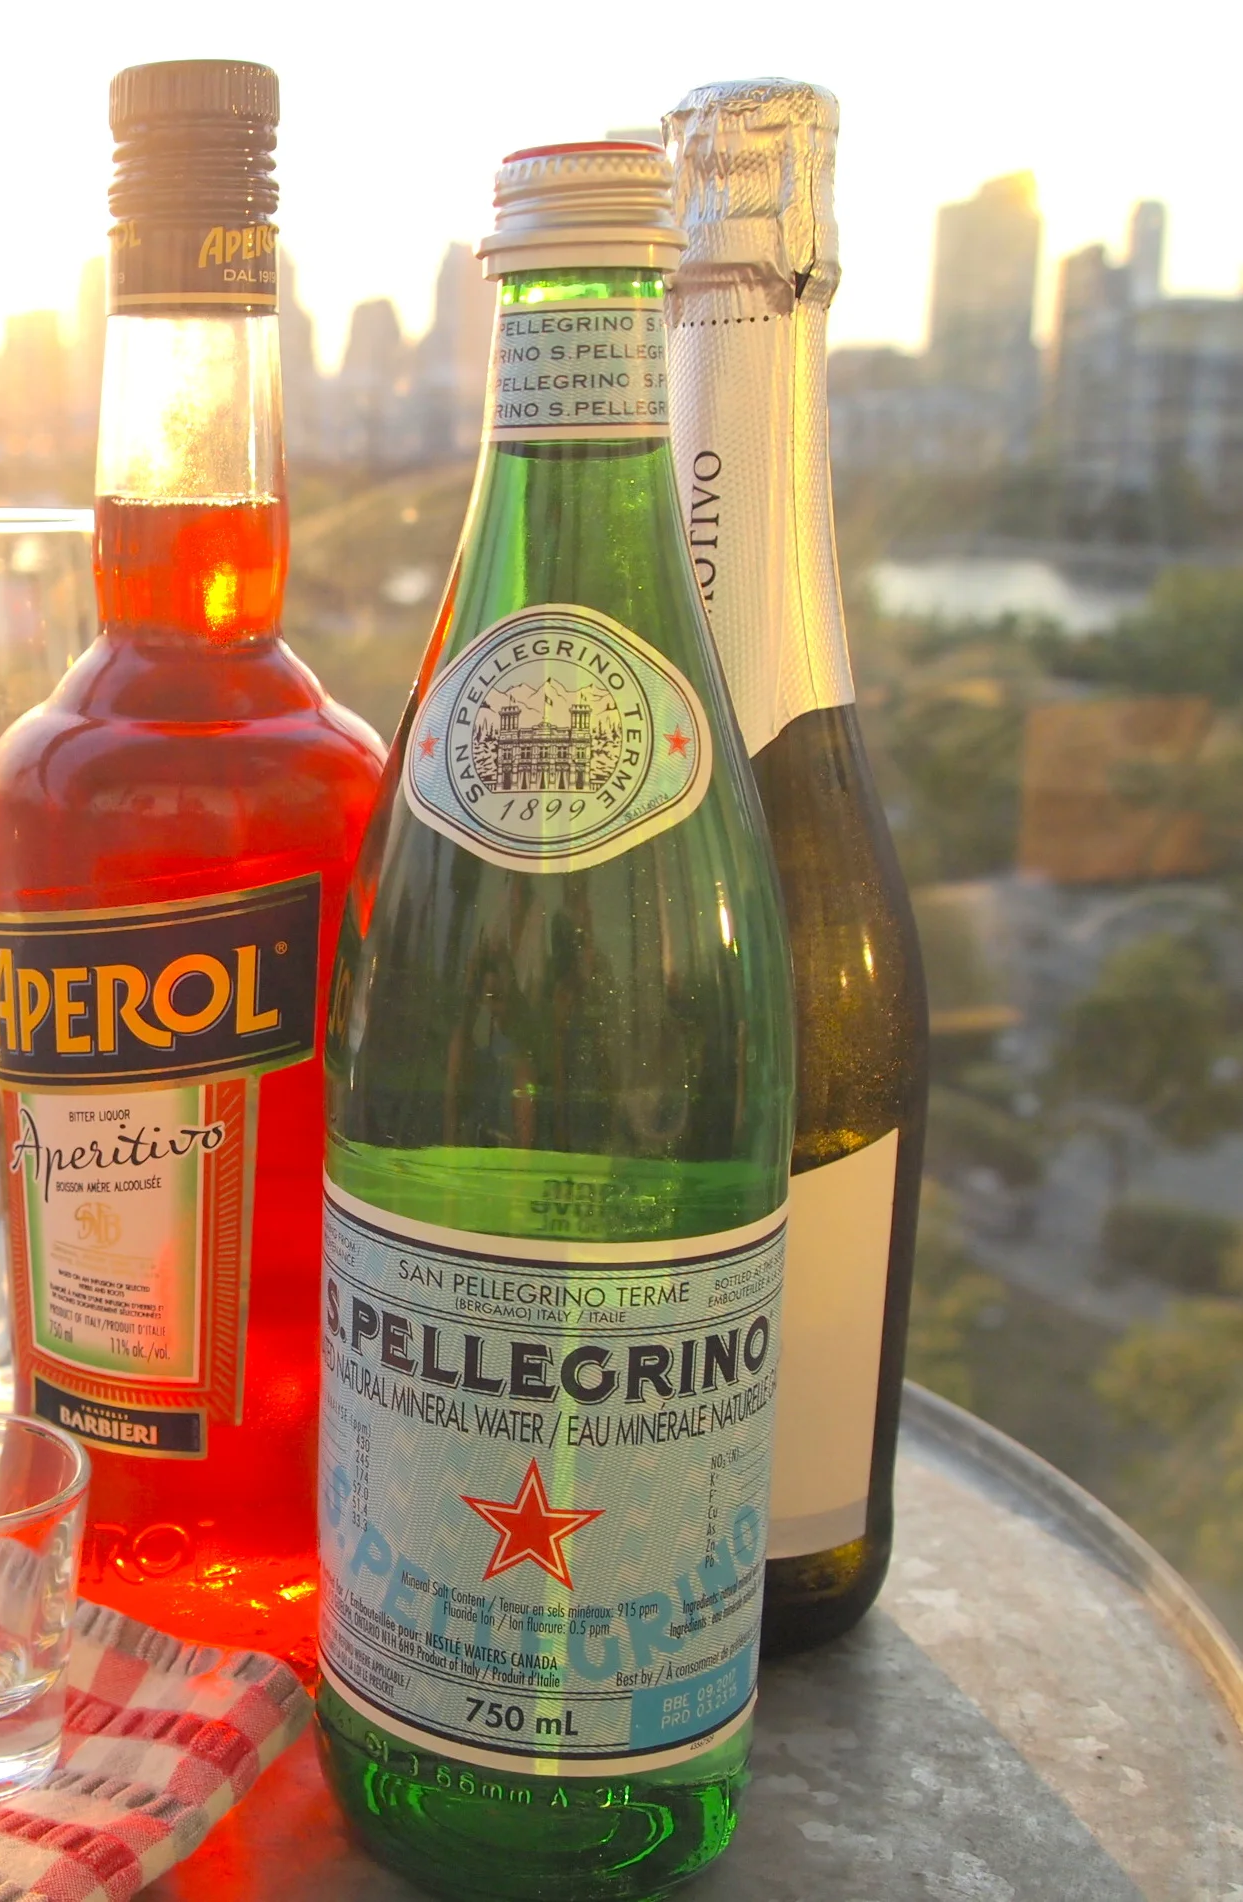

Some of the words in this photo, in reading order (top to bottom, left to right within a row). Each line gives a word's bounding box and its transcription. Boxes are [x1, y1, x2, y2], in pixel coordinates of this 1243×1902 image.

[224, 269, 256, 281] DAL
[690, 450, 722, 613] OTIVO
[456, 639, 626, 726] PELLEGRINO
[455, 744, 485, 804] SAN
[596, 702, 644, 810] TERME
[499, 798, 586, 822] 1899
[68, 1110, 95, 1123] BITTER
[99, 1109, 131, 1121] LIQUOR
[12, 1107, 225, 1203] Aperitivo
[55, 1181, 84, 1192] BOISSON
[87, 1178, 111, 1192] AMÈRE
[114, 1174, 162, 1191] ALCOOLISÉE
[398, 1258, 444, 1289] SAN
[453, 1272, 606, 1309] PELLEGRINO
[616, 1282, 690, 1307] TERME
[714, 1270, 752, 1290] BOTTLED
[455, 1296, 532, 1322] (BERGAMO)
[537, 1308, 572, 1323] ITALY
[589, 1311, 626, 1323] ITALIE
[49, 1319, 63, 1339] 750
[111, 1337, 130, 1357] 11%
[327, 1278, 770, 1407] S.PELLEGRINO
[336, 1351, 388, 1408] NATURAL
[391, 1383, 469, 1433] MINERAL
[475, 1404, 544, 1444] WATER
[567, 1415, 611, 1447] EAU
[616, 1403, 707, 1446] MINÉRALE
[710, 1375, 769, 1433] NATURELLE
[59, 1404, 159, 1446] BARBIERI
[707, 1506, 719, 1520] Cu
[707, 1523, 716, 1536] As
[704, 1552, 715, 1569] Pb
[706, 1538, 716, 1553] Zn
[401, 1570, 431, 1594] Mineral
[432, 1582, 450, 1599] Salt
[451, 1587, 486, 1609] Content
[499, 1597, 530, 1616] Teneur
[532, 1604, 545, 1617] en
[547, 1602, 566, 1618] sels
[567, 1602, 615, 1620] minéraux:
[617, 1602, 637, 1617] 915
[638, 1602, 659, 1620] ppm
[350, 1590, 396, 1632] Embouteillée
[398, 1624, 423, 1644] pour:
[425, 1630, 461, 1657] NESTLÉ
[464, 1643, 508, 1666] WATERS
[510, 1651, 558, 1671] CANADA
[443, 1602, 478, 1623] Fluoride
[480, 1609, 496, 1627] Ion
[509, 1614, 524, 1631] Ion
[526, 1616, 566, 1634] fluorure:
[569, 1620, 586, 1636] 0.5
[588, 1622, 611, 1638] ppm
[354, 1611, 380, 1641] ONTARIO
[381, 1629, 397, 1649] N1H
[398, 1638, 415, 1656] 6H9
[416, 1648, 448, 1669] Product
[449, 1656, 460, 1672] of
[460, 1658, 481, 1680] Italy
[492, 1665, 526, 1685] Produit
[527, 1671, 561, 1688] d'Italie
[372, 1657, 406, 1688] APPLICABLE
[615, 1670, 638, 1687] Best
[641, 1668, 653, 1687] by
[675, 1651, 719, 1678] consommer
[663, 1692, 691, 1713] BBE
[697, 1667, 737, 1702] 09.2017
[466, 1697, 525, 1732] 750
[535, 1710, 579, 1736] mL
[661, 1709, 691, 1730] PRD
